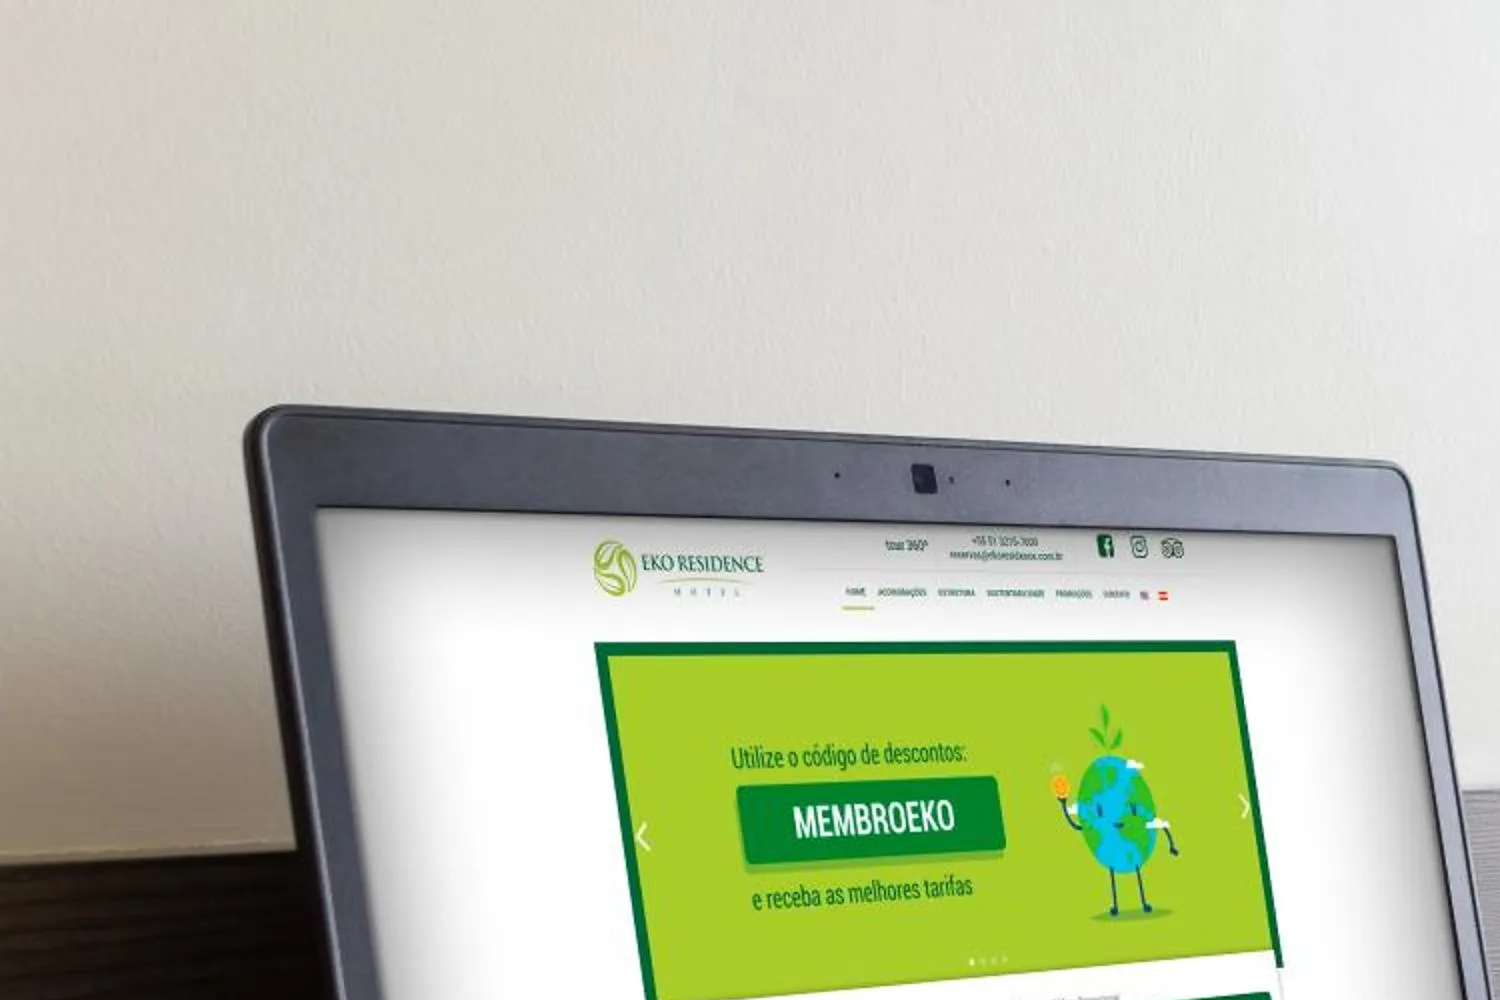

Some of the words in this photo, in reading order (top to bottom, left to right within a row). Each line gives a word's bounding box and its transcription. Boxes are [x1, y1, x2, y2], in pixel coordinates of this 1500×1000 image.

[640, 554, 674, 571] EKO
[677, 554, 765, 573] RESIDENCE
[731, 745, 785, 769] Utilize
[788, 751, 798, 767] o
[803, 744, 857, 771] código
[860, 743, 880, 765] de
[884, 743, 967, 765] descontos:
[792, 799, 956, 839] MEMBROEKO
[751, 893, 763, 911] e
[766, 884, 821, 910] receba
[825, 889, 845, 906] as
[848, 879, 921, 904] melhores
[924, 874, 974, 901] tarifas
